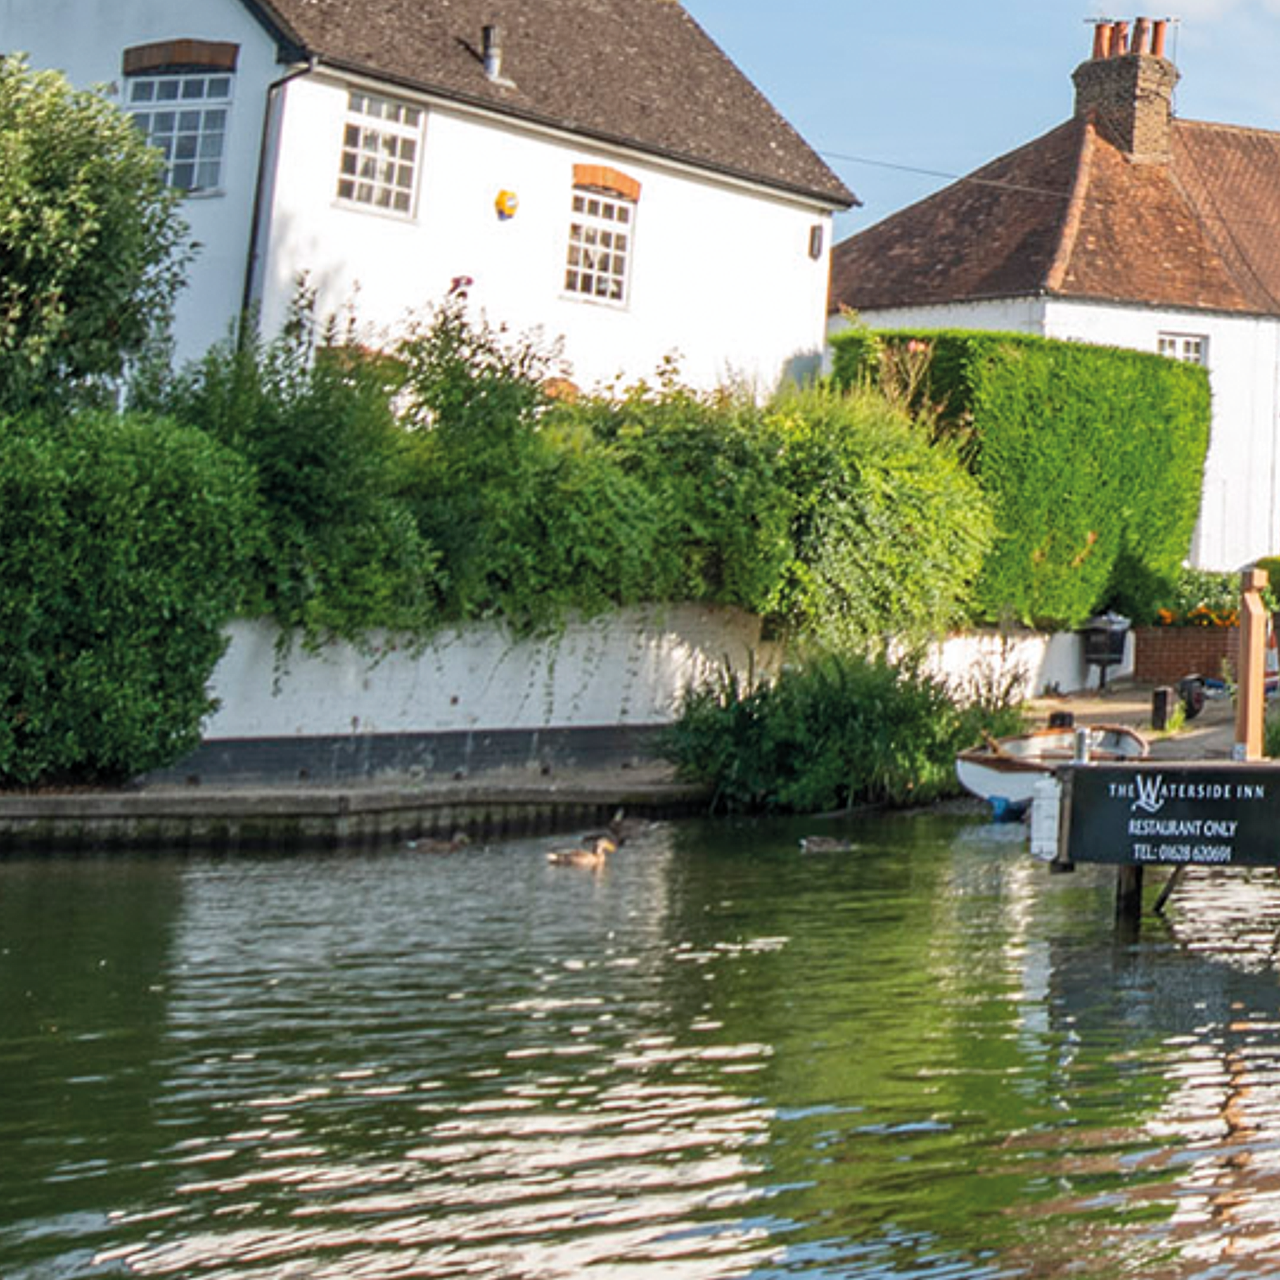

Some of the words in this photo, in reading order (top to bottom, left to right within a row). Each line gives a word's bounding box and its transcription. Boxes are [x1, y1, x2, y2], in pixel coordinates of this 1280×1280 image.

[1109, 783, 1134, 797] THE
[1131, 774, 1231, 813] WATERSIDE
[1236, 784, 1265, 799] INN
[1128, 819, 1201, 836] RESTAURANT
[1204, 820, 1238, 837] ONLY
[1133, 843, 1157, 860] TEL:
